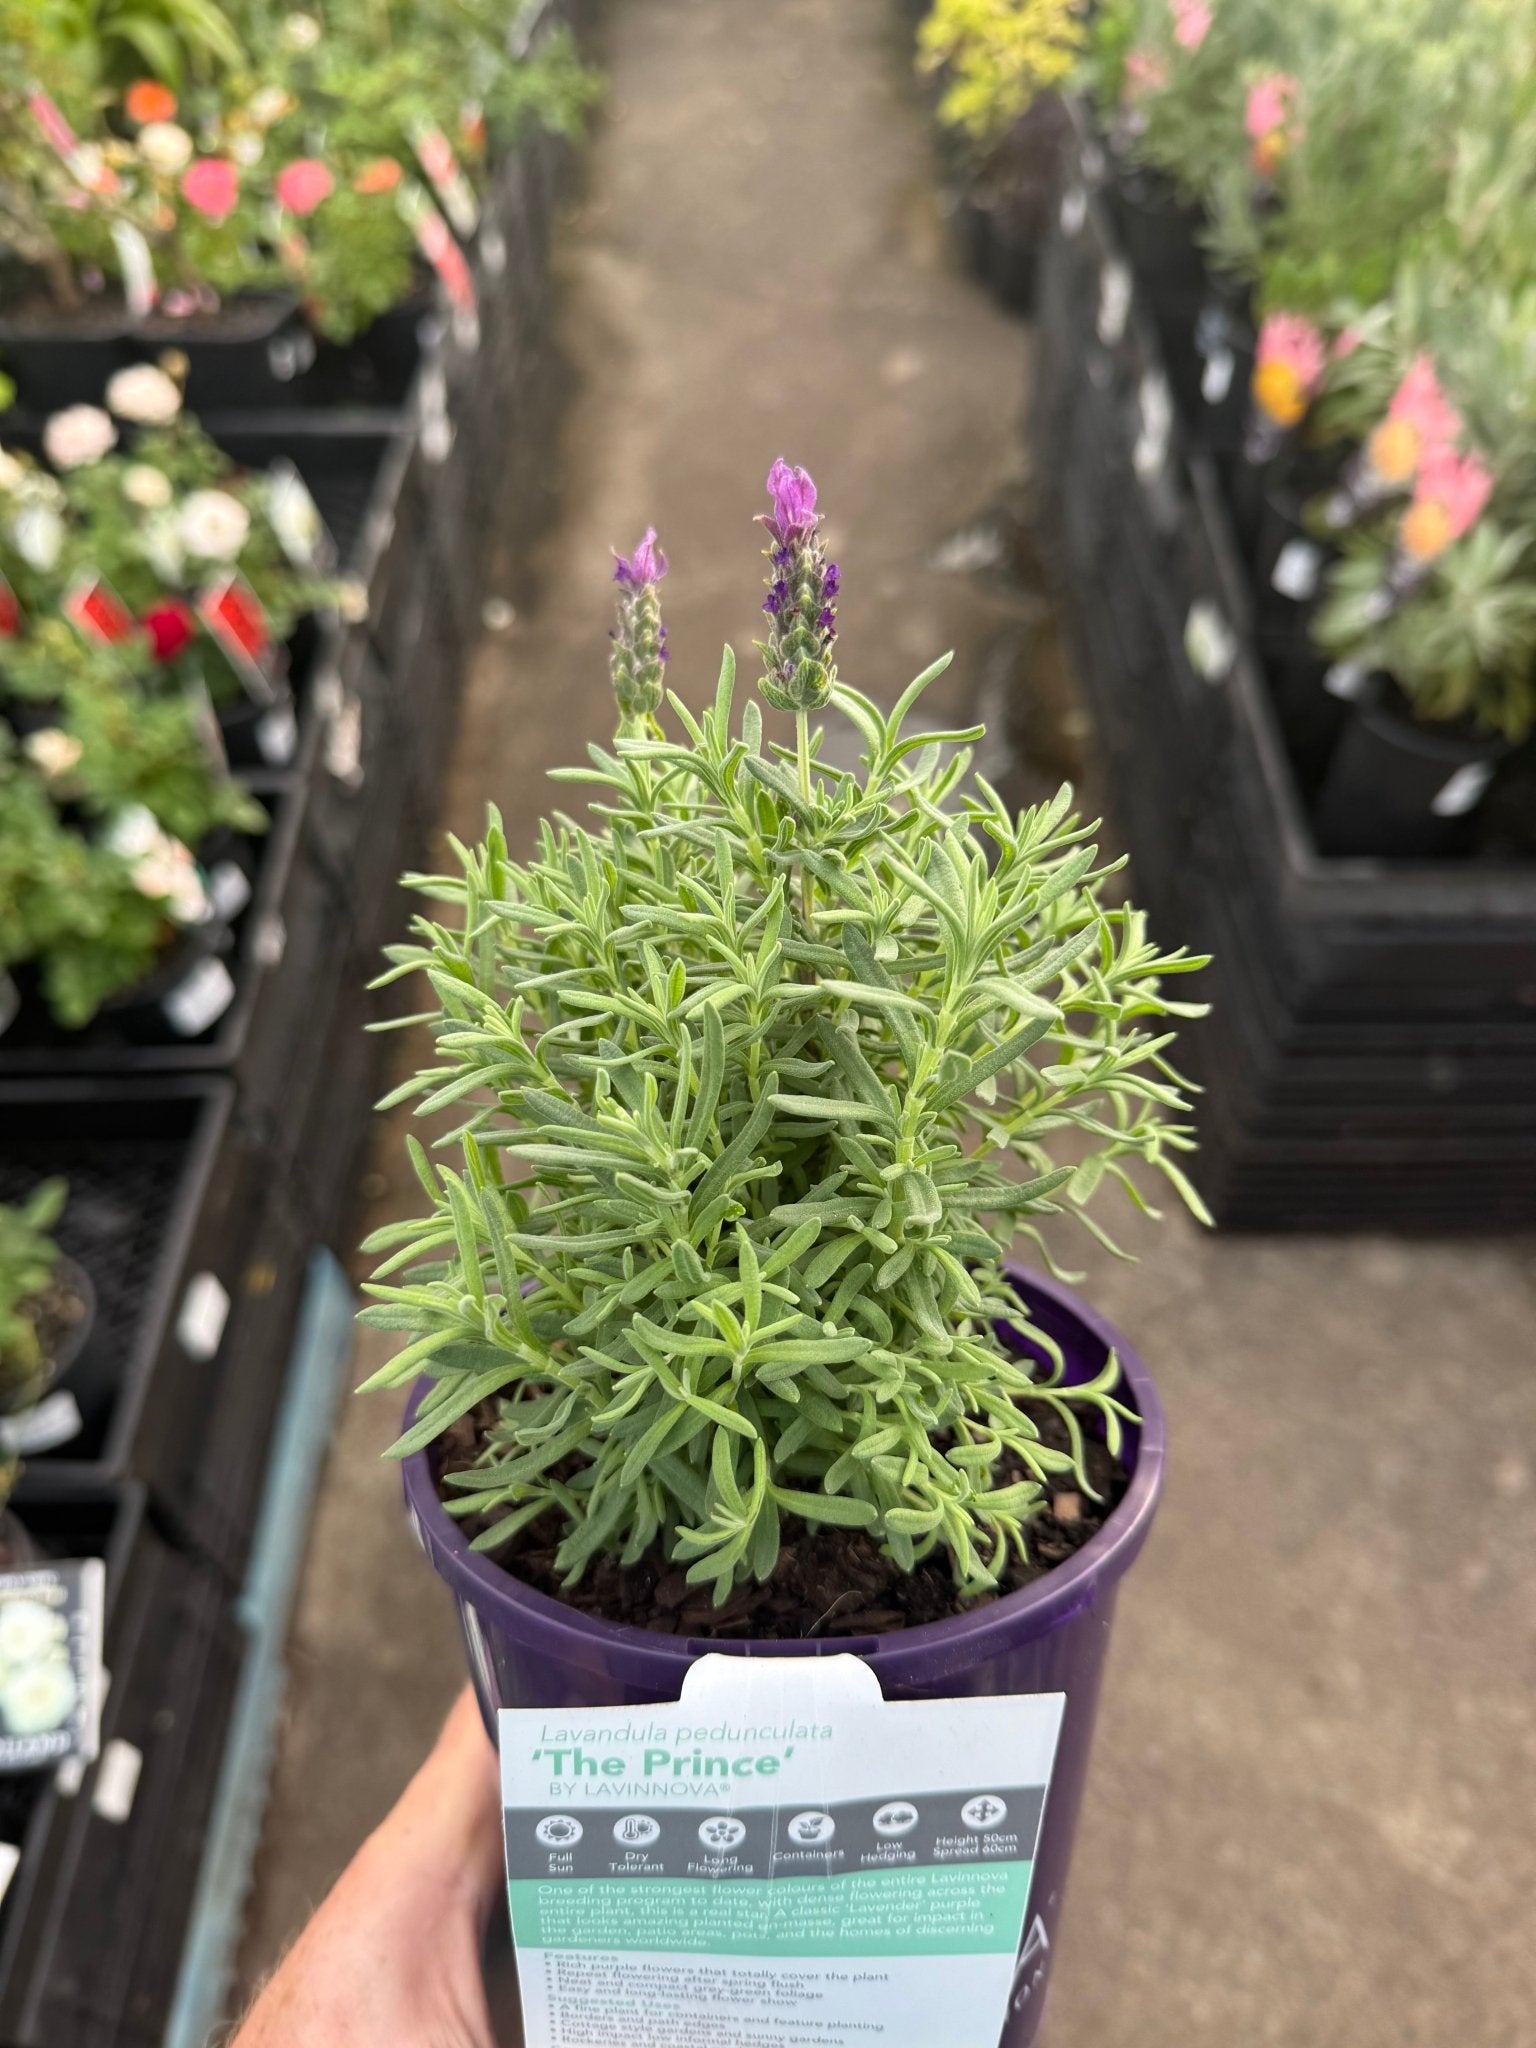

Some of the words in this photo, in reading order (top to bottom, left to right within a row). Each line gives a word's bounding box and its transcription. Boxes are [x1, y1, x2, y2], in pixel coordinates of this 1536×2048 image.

[541, 1720, 667, 1742] Lavandula
[675, 1718, 833, 1745] pedunculata
[549, 1782, 576, 1796] BY
[876, 1841, 902, 1850] Low
[936, 1836, 978, 1847] Height
[983, 1833, 1018, 1843] 50cm
[772, 1848, 844, 1860] Containers
[933, 1845, 978, 1857] Spread
[982, 1843, 1017, 1852] 60cm
[549, 1853, 573, 1862] Full
[625, 1851, 648, 1863] Dry
[704, 1854, 737, 1865] Long
[861, 1851, 915, 1864] Hedging
[549, 1863, 573, 1872] Sun
[608, 1862, 664, 1872] Tolerant
[687, 1862, 753, 1873] Flowering
[538, 1885, 573, 1895] One
[578, 1884, 594, 1894] of
[600, 1884, 625, 1894] the
[631, 1885, 705, 1896] strongest
[713, 1884, 760, 1895] flower
[768, 1883, 825, 1895] colours
[831, 1879, 847, 1889] of
[852, 1877, 876, 1888] the
[881, 1874, 926, 1886] entire
[931, 1871, 1008, 1884] Lavinnova
[539, 1895, 611, 1906] breeding
[617, 1897, 686, 1907] program
[691, 1896, 707, 1905] to
[758, 1896, 792, 1906] with
[797, 1894, 845, 1905] dense
[850, 1889, 922, 1901] flowering
[927, 1886, 975, 1897] across
[981, 1882, 1006, 1894] the
[540, 1906, 585, 1915] entire
[640, 1906, 668, 1915] this
[673, 1906, 684, 1915] is
[703, 1907, 731, 1916] real
[774, 1908, 786, 1917] A
[791, 1904, 840, 1915] classic
[930, 1896, 981, 1911] purple
[541, 1916, 570, 1925] that
[577, 1916, 618, 1925] looks
[624, 1917, 688, 1927] amazing
[693, 1917, 753, 1928] planted
[841, 1915, 881, 1927] great
[888, 1912, 907, 1923] for
[914, 1911, 965, 1924] impact
[970, 1910, 983, 1920] in
[542, 1926, 566, 1934] the
[637, 1926, 676, 1937] patio
[776, 1927, 805, 1938] and
[810, 1927, 834, 1937] the
[840, 1927, 891, 1937] homes
[896, 1924, 911, 1935] of
[916, 1923, 994, 1935] discerning
[542, 1935, 620, 1945] gardeners
[544, 1952, 619, 1962] Features
[558, 1961, 587, 1969] Rich
[591, 1963, 637, 1972] purple
[642, 1964, 694, 1973] flowers
[699, 1967, 726, 1976] that
[732, 1969, 777, 1980] totally
[781, 1972, 820, 1981] cover
[825, 1971, 848, 1981] the
[853, 1972, 889, 1983] plant
[613, 1971, 679, 1983] flowering
[722, 1978, 766, 1989] spring
[771, 1980, 804, 1990] flush
[760, 1996, 798, 2006] show
[776, 1989, 823, 2000] foliage
[774, 2017, 823, 2028] feature
[827, 2020, 884, 2032] planting
